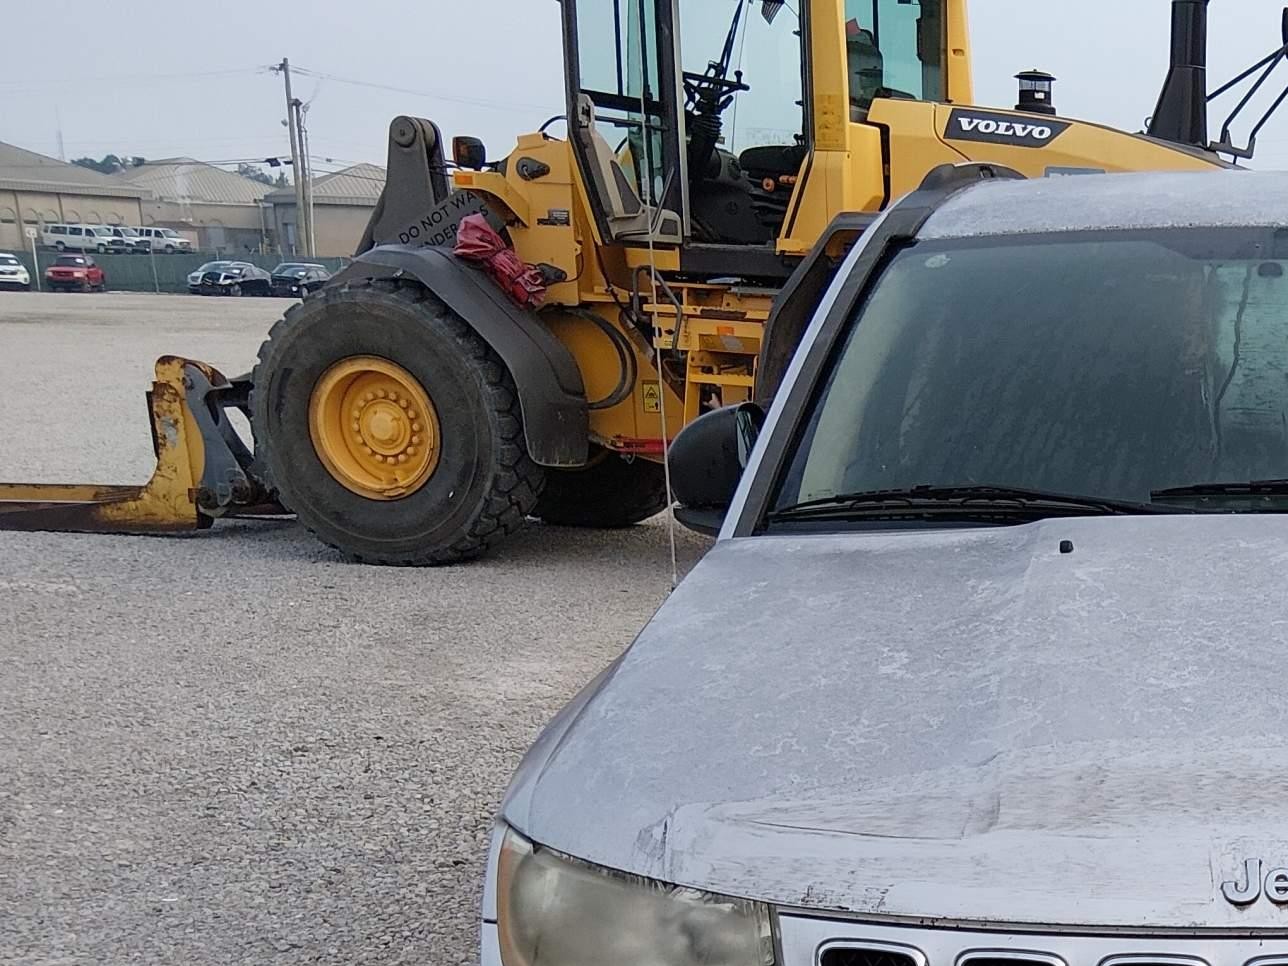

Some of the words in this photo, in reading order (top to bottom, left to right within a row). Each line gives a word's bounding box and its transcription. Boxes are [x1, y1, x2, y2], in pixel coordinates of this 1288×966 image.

[957, 117, 1052, 139] VOLVO
[399, 225, 420, 245] DO
[420, 204, 449, 232] NOT
[450, 191, 477, 209] WA
[418, 223, 458, 248] NDER
